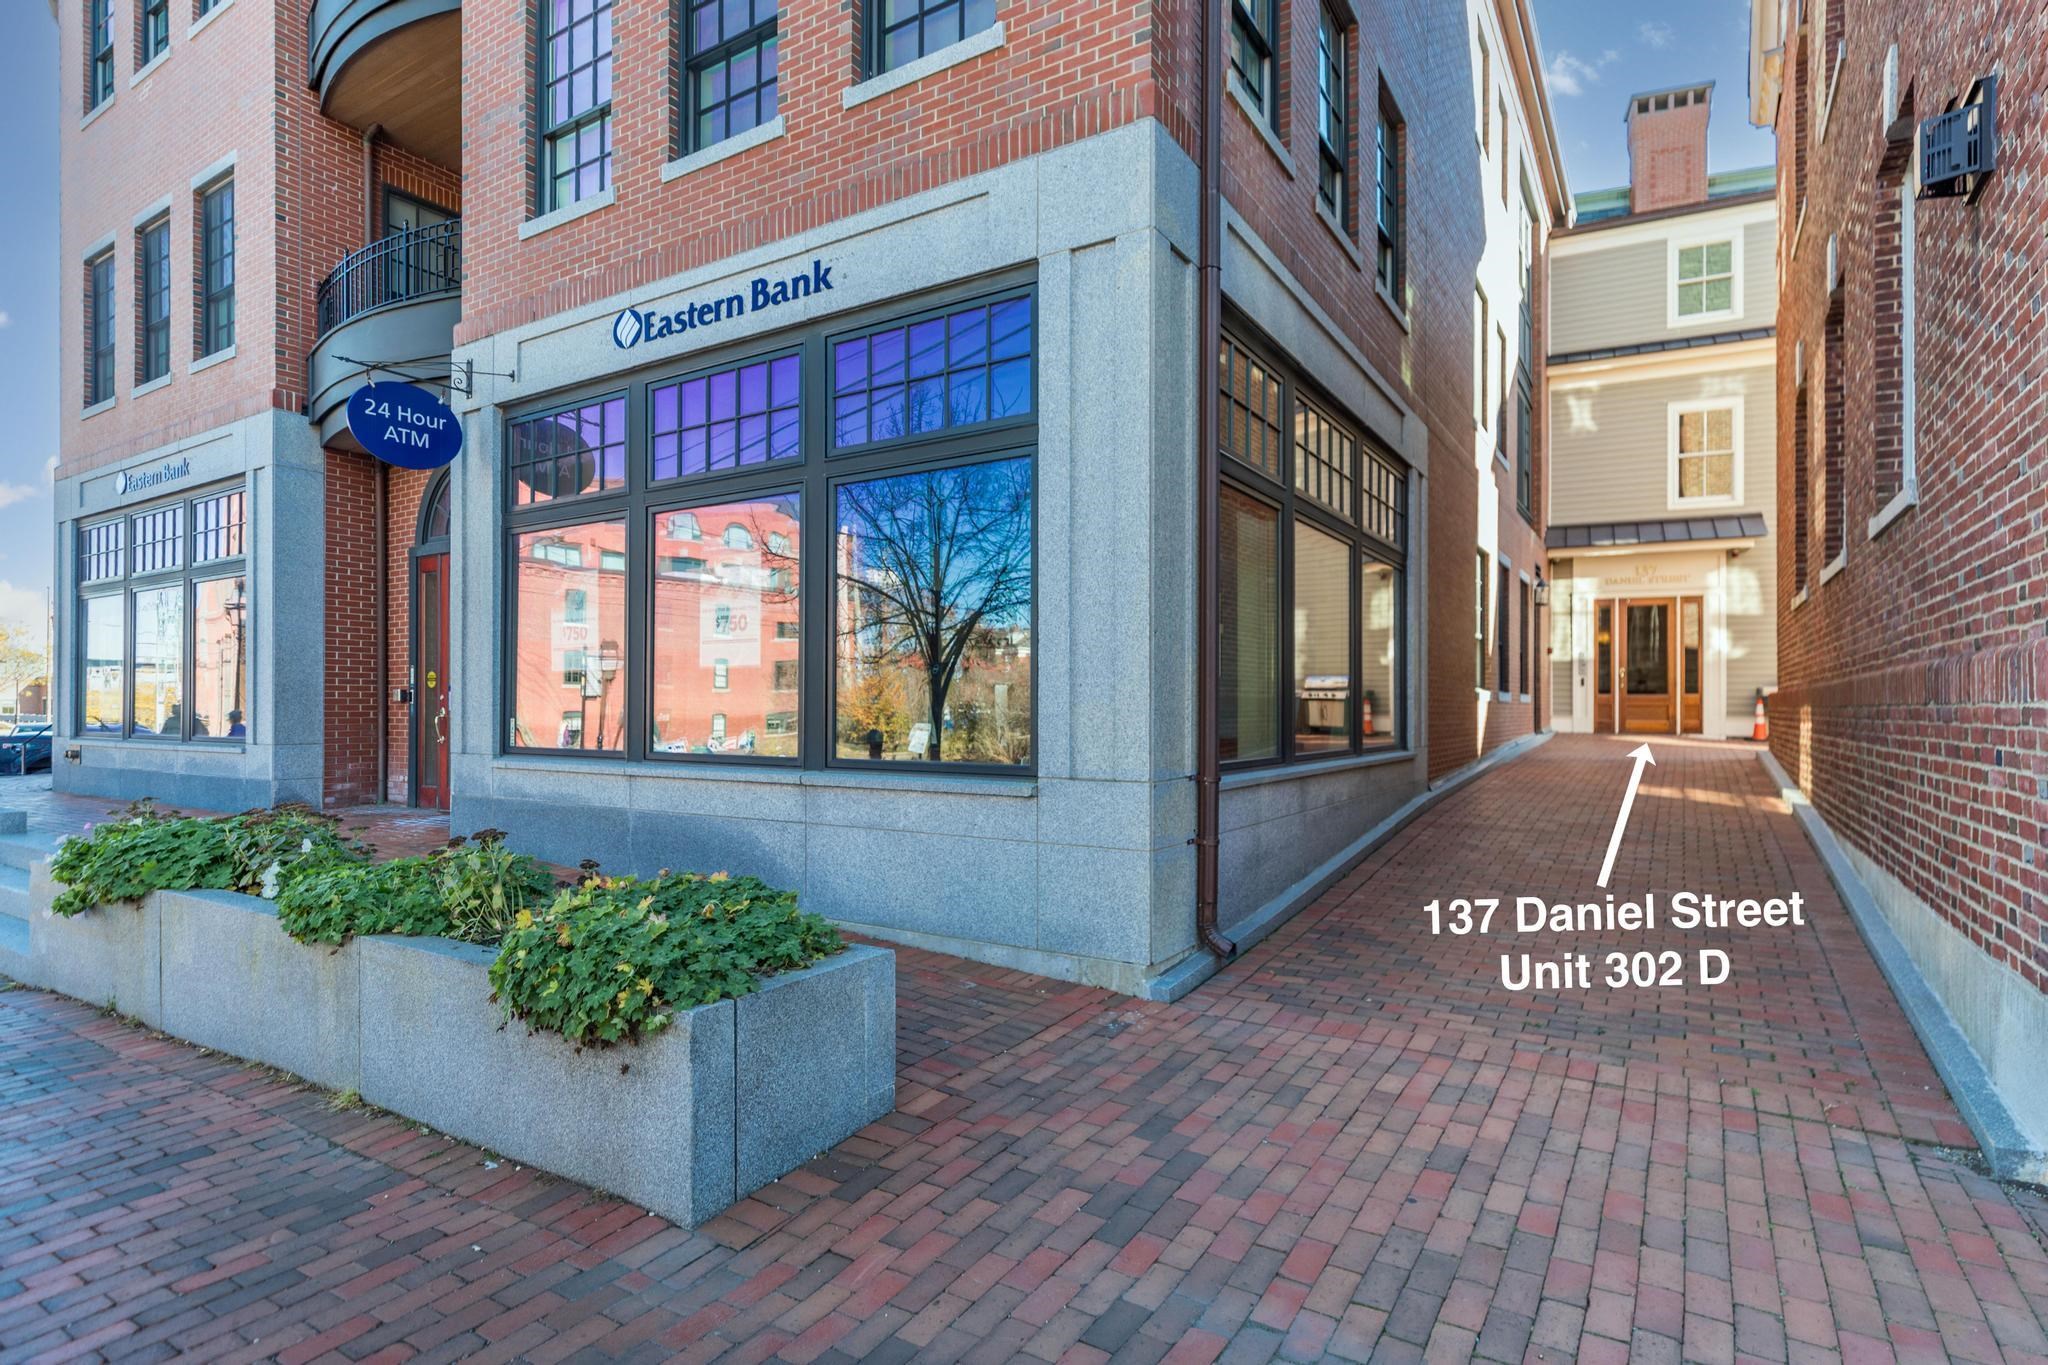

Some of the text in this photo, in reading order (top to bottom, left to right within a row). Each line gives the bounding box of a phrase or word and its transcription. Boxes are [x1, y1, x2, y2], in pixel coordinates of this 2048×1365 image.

[643, 259, 834, 343] Eastern Bank
[364, 398, 447, 431] 24 Hour
[383, 425, 430, 449] ATM
[128, 457, 190, 492] Eastern Bank
[715, 613, 748, 633] $750
